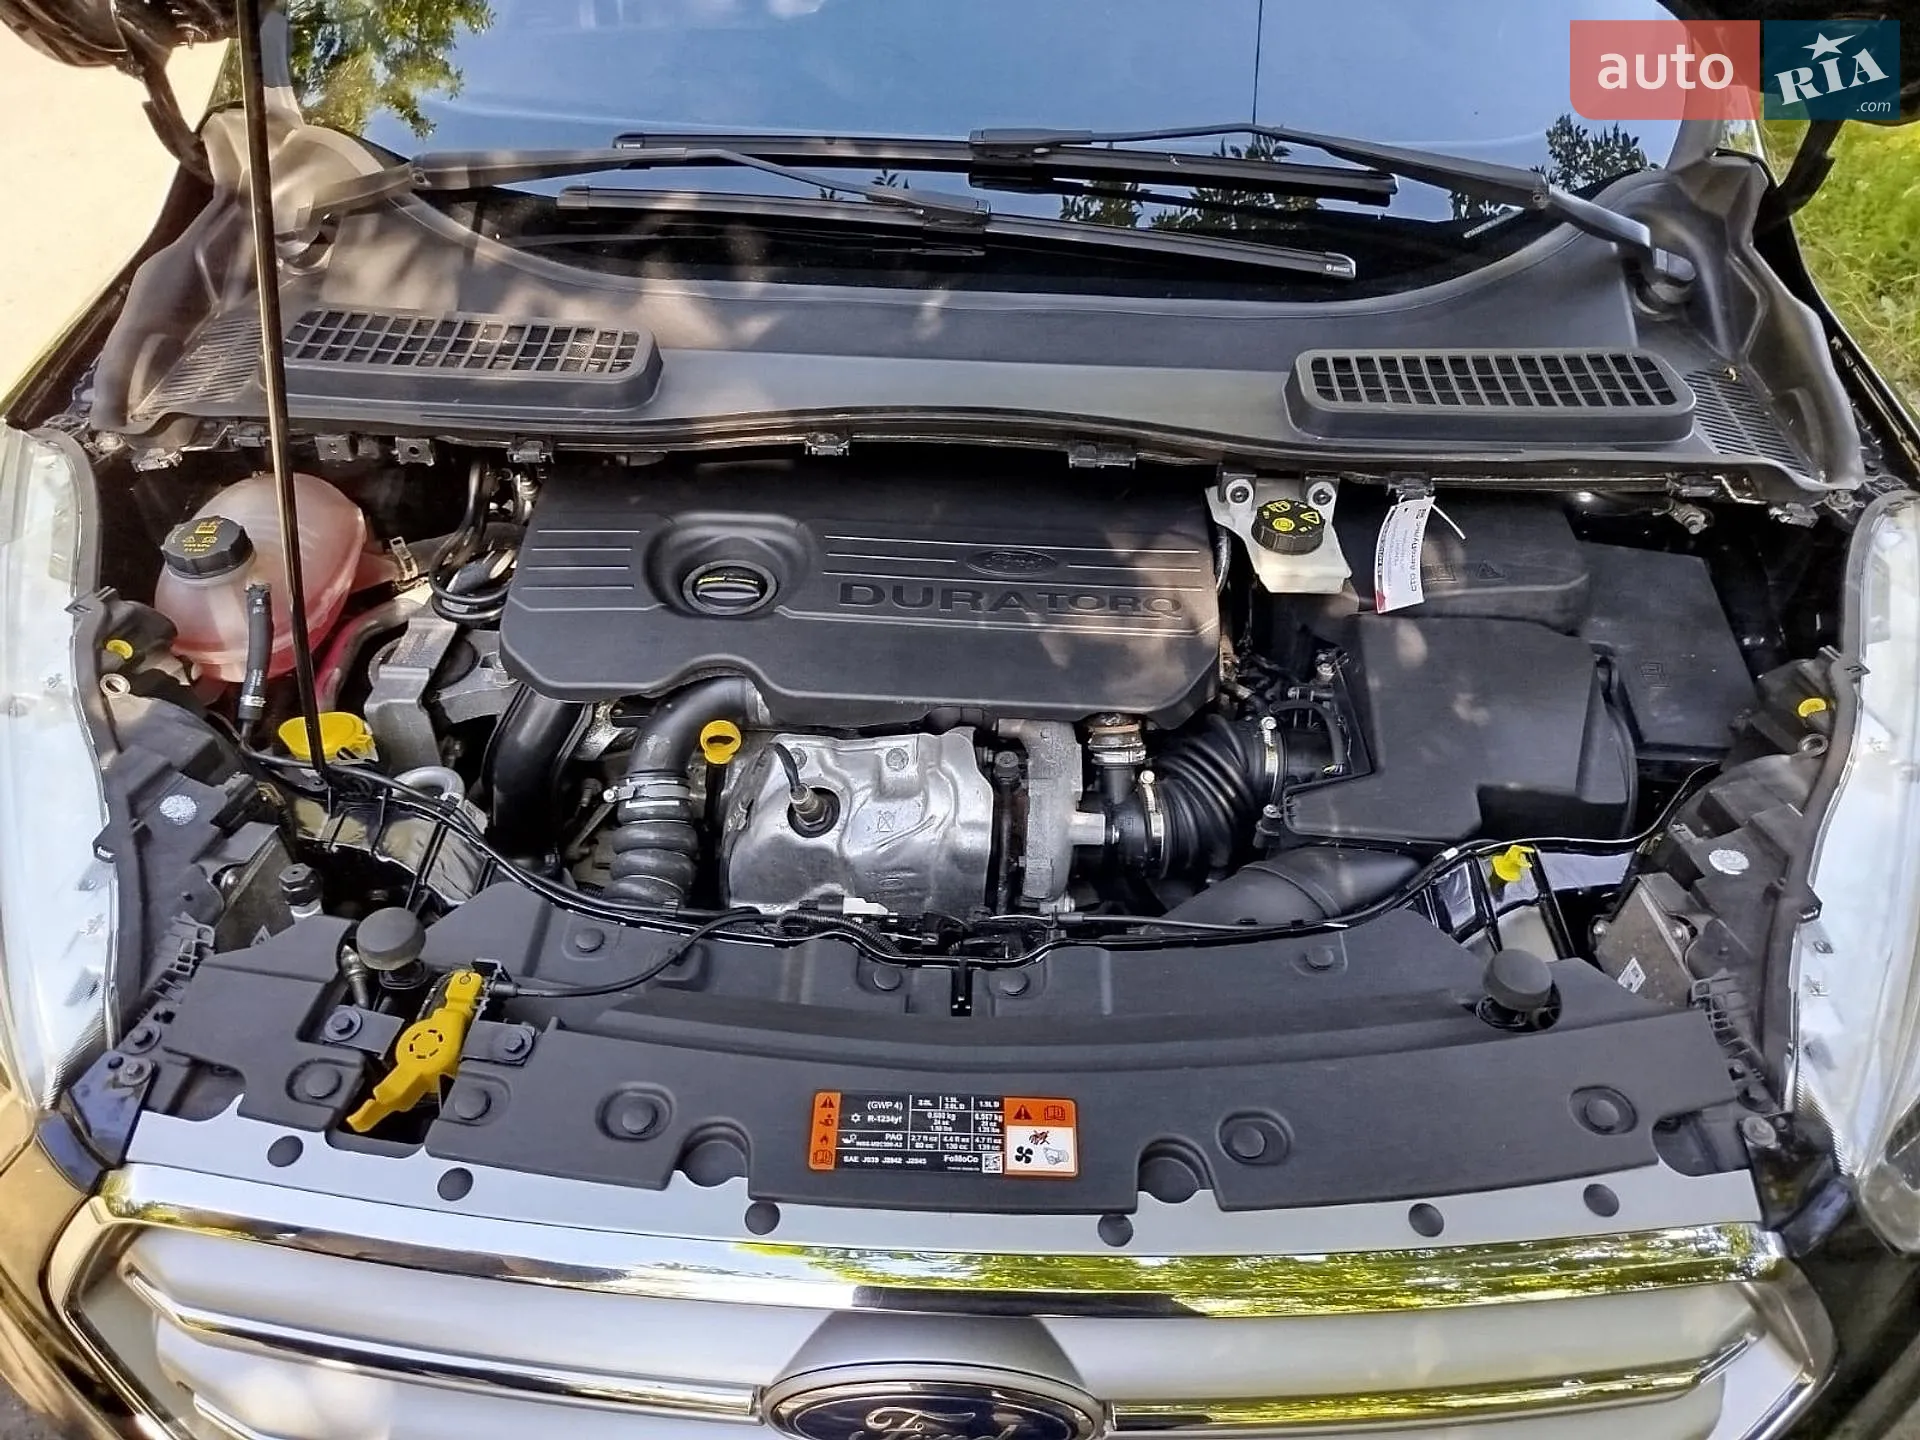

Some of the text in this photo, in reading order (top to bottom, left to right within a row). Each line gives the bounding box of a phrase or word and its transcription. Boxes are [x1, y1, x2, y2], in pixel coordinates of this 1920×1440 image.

[838, 582, 1182, 620] DURATORQ
[867, 1101, 893, 1110] (GWP
[867, 1115, 903, 1125] R-1234yf
[885, 1133, 903, 1141] PAG
